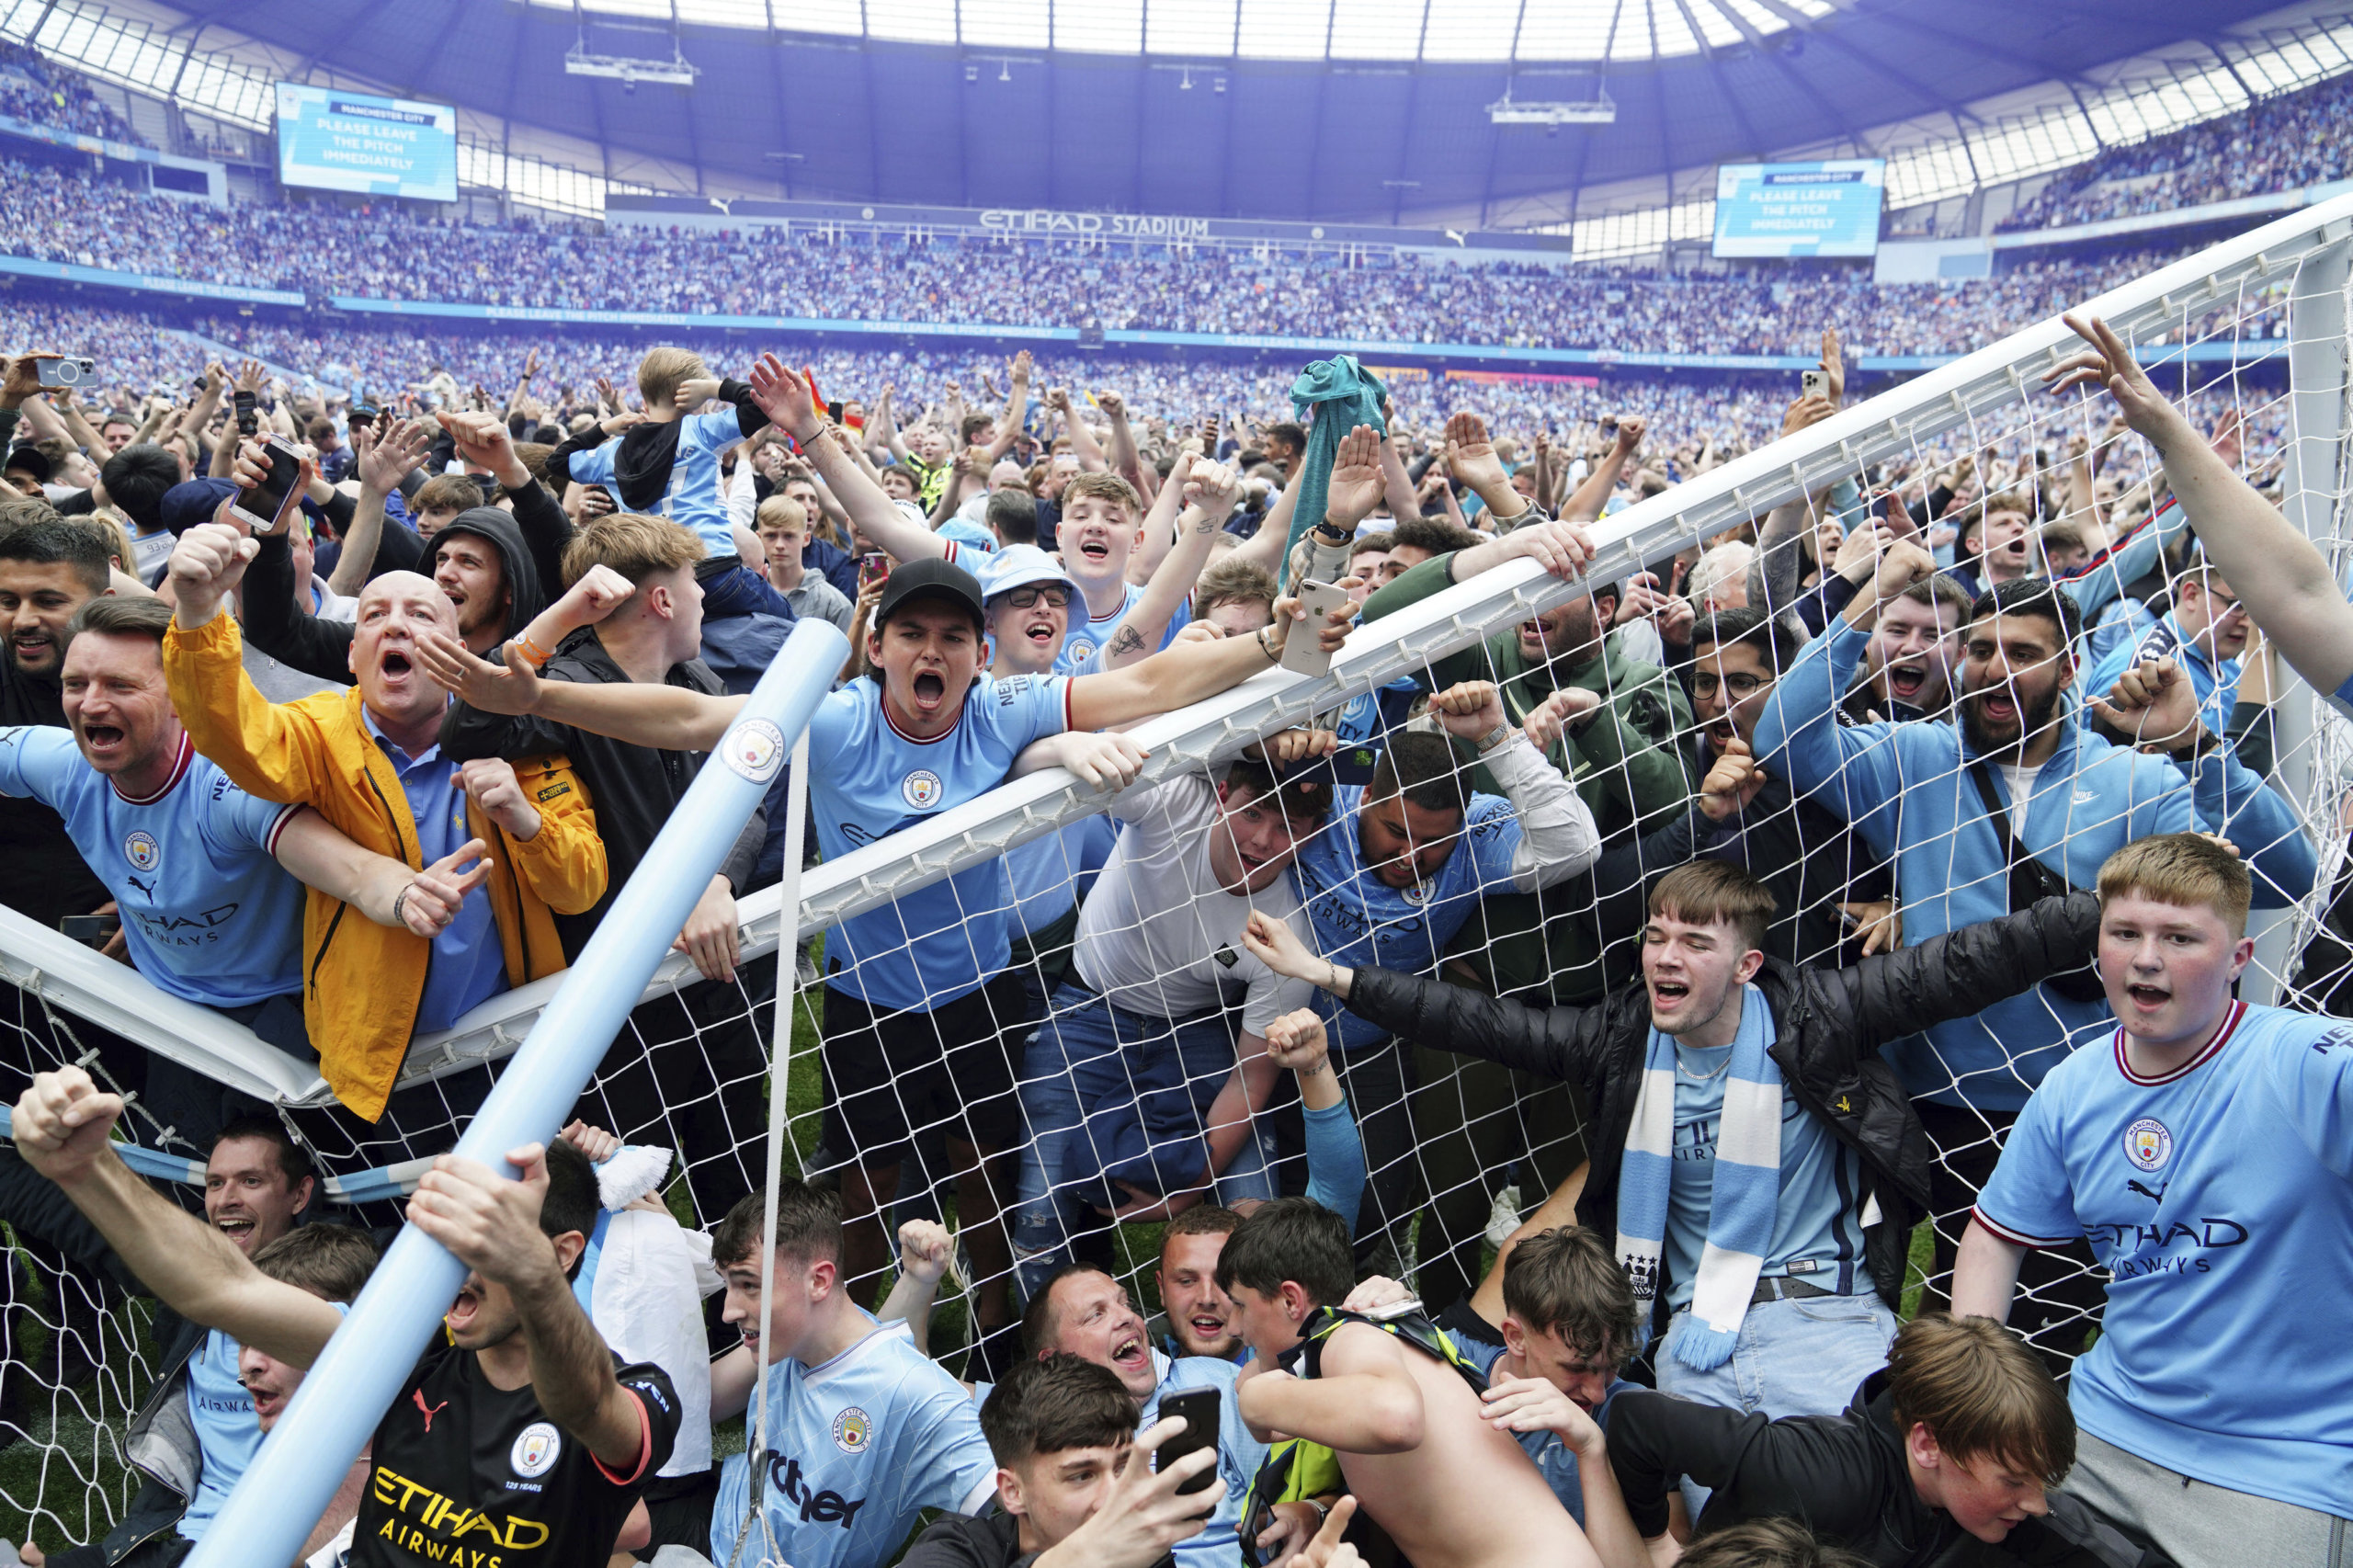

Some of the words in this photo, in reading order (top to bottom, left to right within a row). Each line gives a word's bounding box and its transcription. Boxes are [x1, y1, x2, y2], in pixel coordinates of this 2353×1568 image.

[341, 104, 404, 120] MANCHESTER
[404, 114, 425, 124] CITY
[317, 118, 370, 136] PLEASE
[372, 125, 417, 142] LEAVE
[333, 135, 360, 149] THE
[363, 139, 404, 154] PITCH
[323, 150, 414, 170] IMMEDIATELY
[1773, 173, 1830, 183] MANCHESTER
[1833, 172, 1853, 181] CITY
[1750, 189, 1797, 202] PLEASE
[1800, 187, 1842, 200] LEAVE
[1762, 204, 1786, 216] THE
[1789, 203, 1827, 215] PITCH
[979, 210, 1103, 231] ETIHAD
[1112, 214, 1209, 236] STADIUM
[1751, 217, 1836, 231] IMMEDIATELY
[486, 307, 526, 319] PLEASE
[528, 308, 562, 320] LEAVE
[736, 721, 782, 758] MANCHESTER
[906, 771, 939, 786] MANCHESTER
[128, 833, 156, 849] MANCHESTER
[2129, 1120, 2168, 1140] MANCHESTER
[835, 1409, 864, 1442] MANCHESTER
[505, 1481, 518, 1490] 125
[519, 1483, 542, 1493] YEARS
[374, 1466, 550, 1550] ETIHAD
